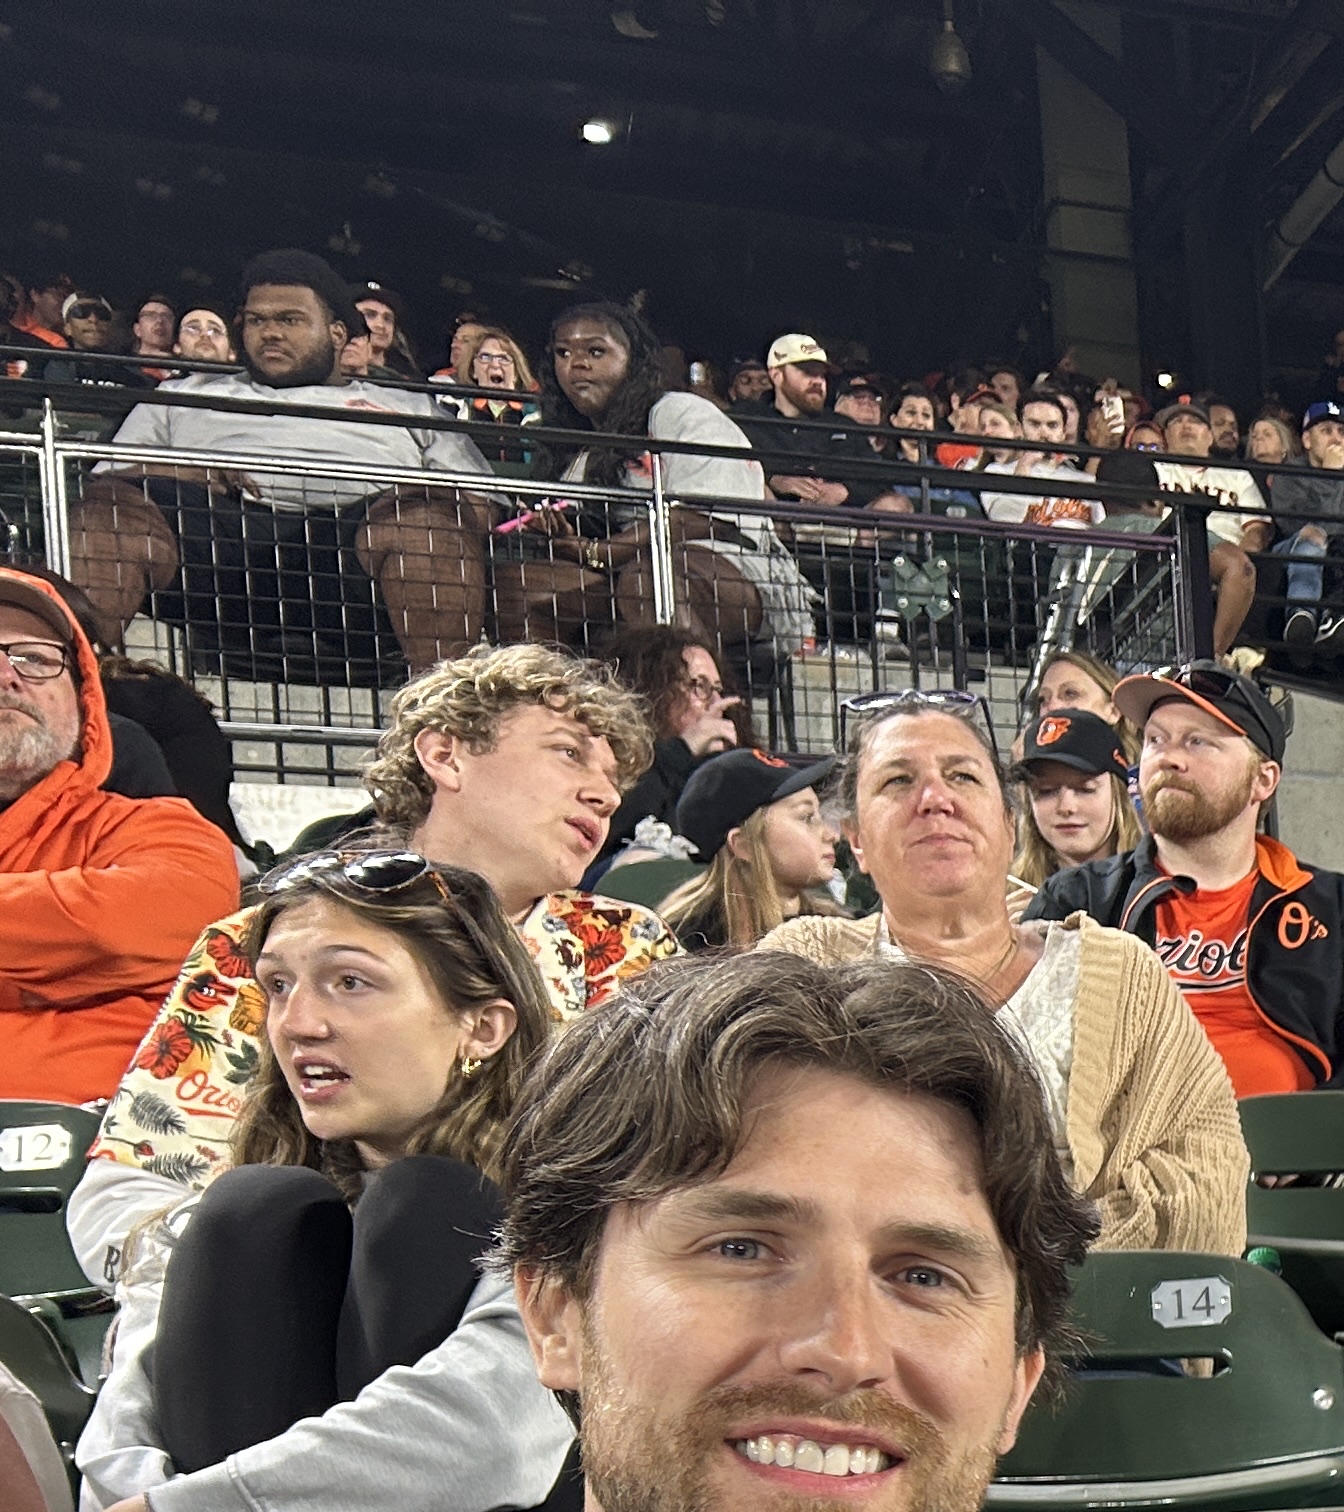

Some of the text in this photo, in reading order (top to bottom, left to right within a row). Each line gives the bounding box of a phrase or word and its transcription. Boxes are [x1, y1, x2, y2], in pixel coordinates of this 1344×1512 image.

[1277, 901, 1329, 950] O's
[176, 1069, 242, 1113] Orio
[14, 1132, 53, 1162] 12
[1171, 1285, 1216, 1320] 14
